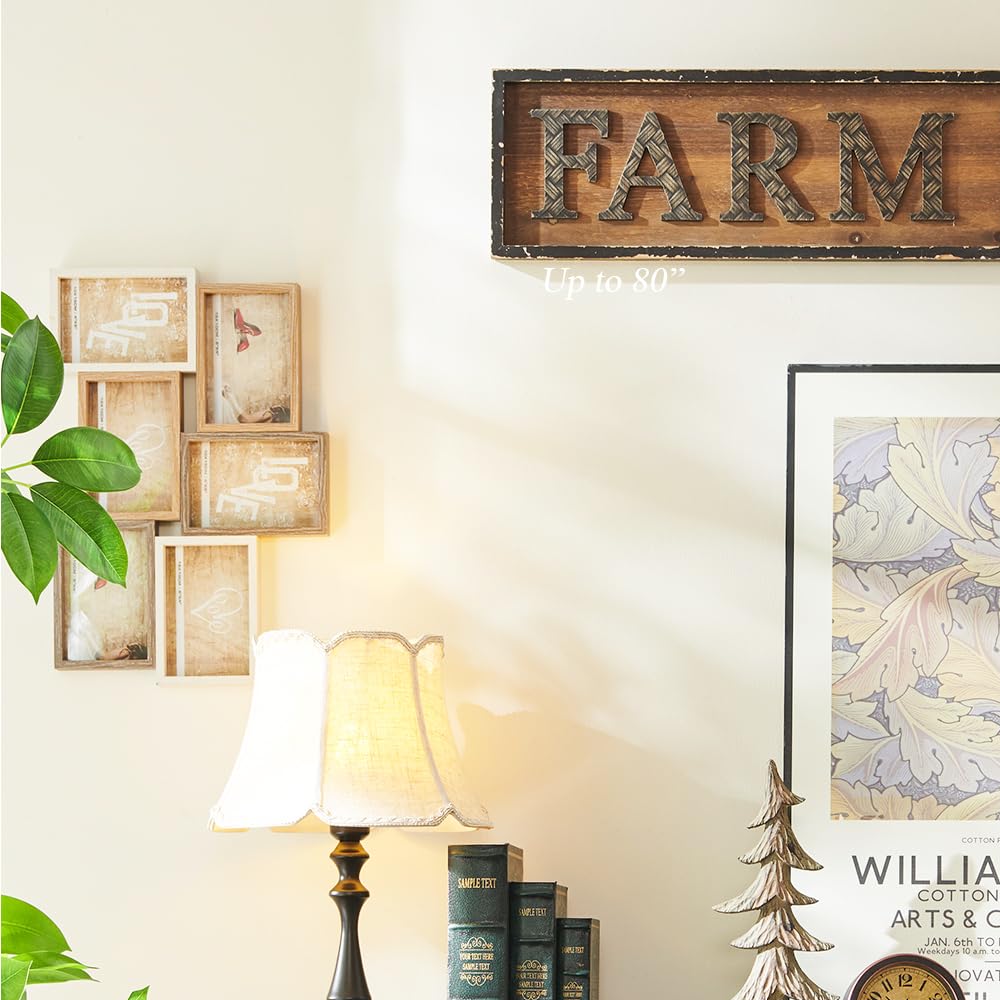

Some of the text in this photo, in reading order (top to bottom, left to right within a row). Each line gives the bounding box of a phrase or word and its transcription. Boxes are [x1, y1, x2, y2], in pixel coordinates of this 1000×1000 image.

[530, 108, 956, 222] FARM
[85, 291, 178, 357] LOVE
[216, 457, 308, 521] LOVE
[458, 878, 497, 889] SAMPLE TEXT
[918, 889, 998, 902] COTTON
[535, 907, 547, 916] TEXT
[890, 909, 955, 928] ARTS
[963, 909, 977, 928] &
[924, 937, 950, 947] JAN.
[954, 937, 973, 947] 6th
[977, 937, 995, 947] TO
[471, 952, 482, 960] TEXT
[482, 952, 494, 960] HERE
[917, 947, 960, 957] Weekdays
[462, 962, 490, 970] SAMPLE TEXT
[881, 978, 893, 992] 11
[898, 973, 912, 987] 12
[919, 980, 927, 991] 1
